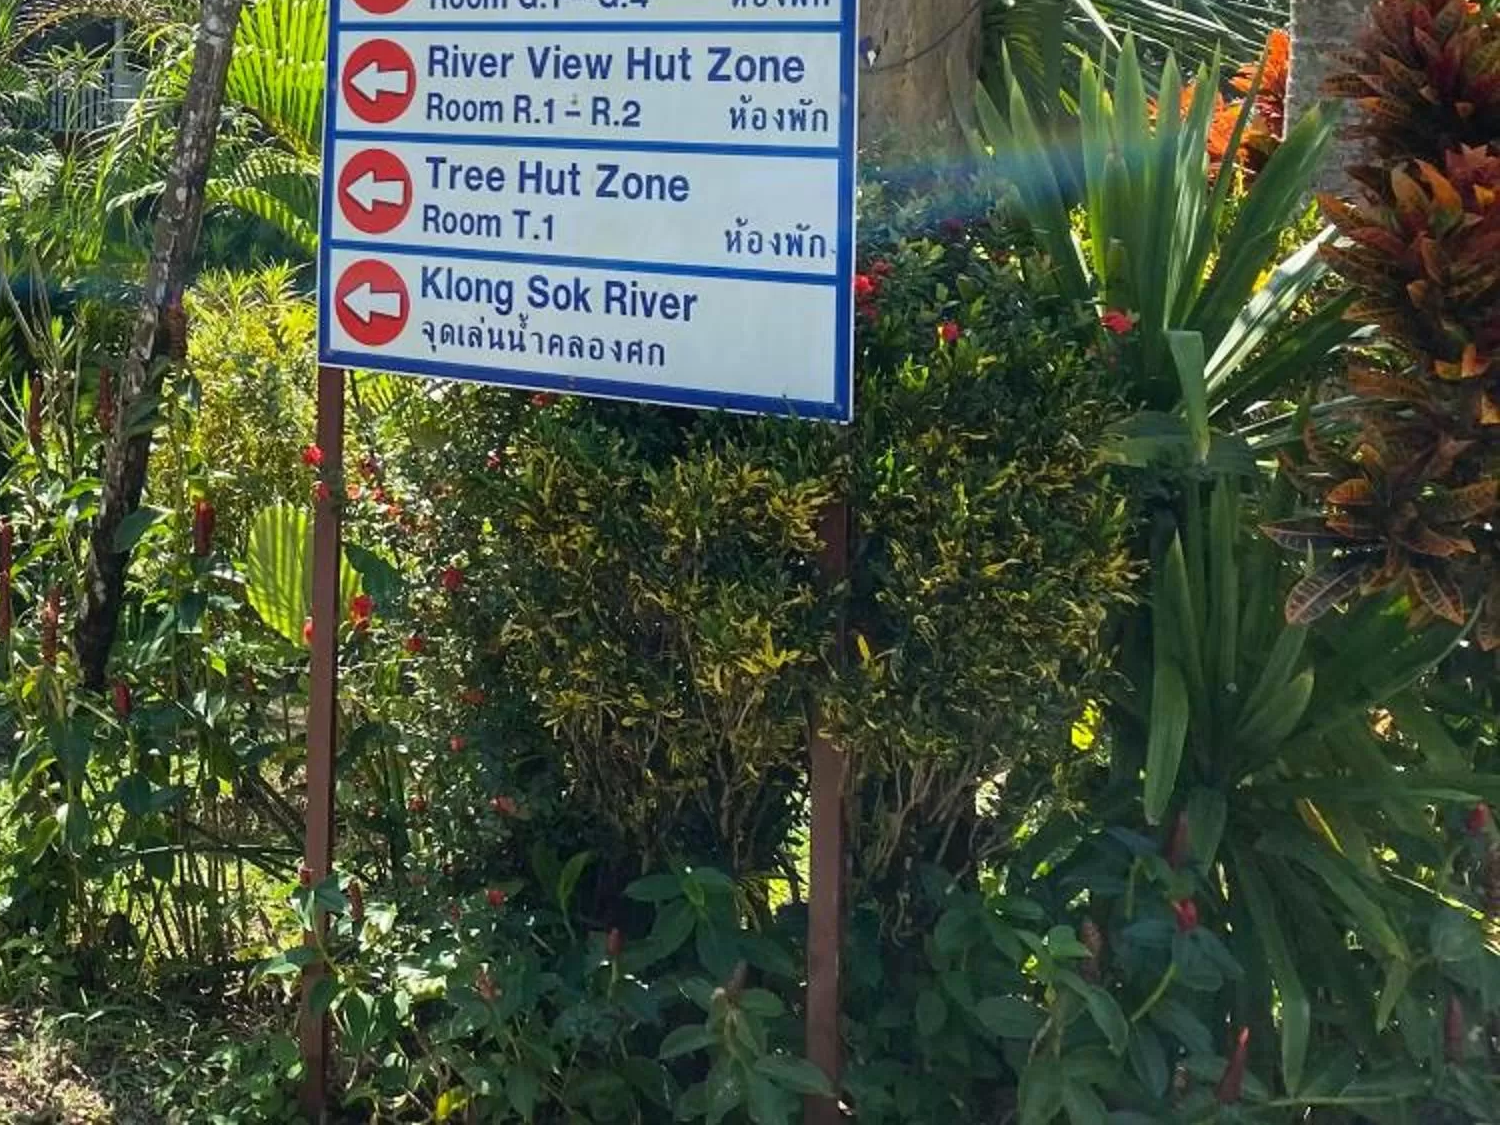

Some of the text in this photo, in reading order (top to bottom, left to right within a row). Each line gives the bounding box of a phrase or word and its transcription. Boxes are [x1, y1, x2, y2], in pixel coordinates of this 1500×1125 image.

[428, 44, 804, 83] River View Hut Zone
[426, 92, 503, 123] Room
[514, 95, 554, 124] R.1
[591, 96, 641, 127] R.2
[729, 95, 828, 132] ห้องพัก
[426, 156, 690, 202] Tree Hut Zone
[423, 204, 553, 241] Room T.1
[725, 217, 826, 258] ห้องพัก
[422, 266, 698, 321] Klong Sok River
[422, 313, 665, 367] จุดเล่นน้ำคลองศก
